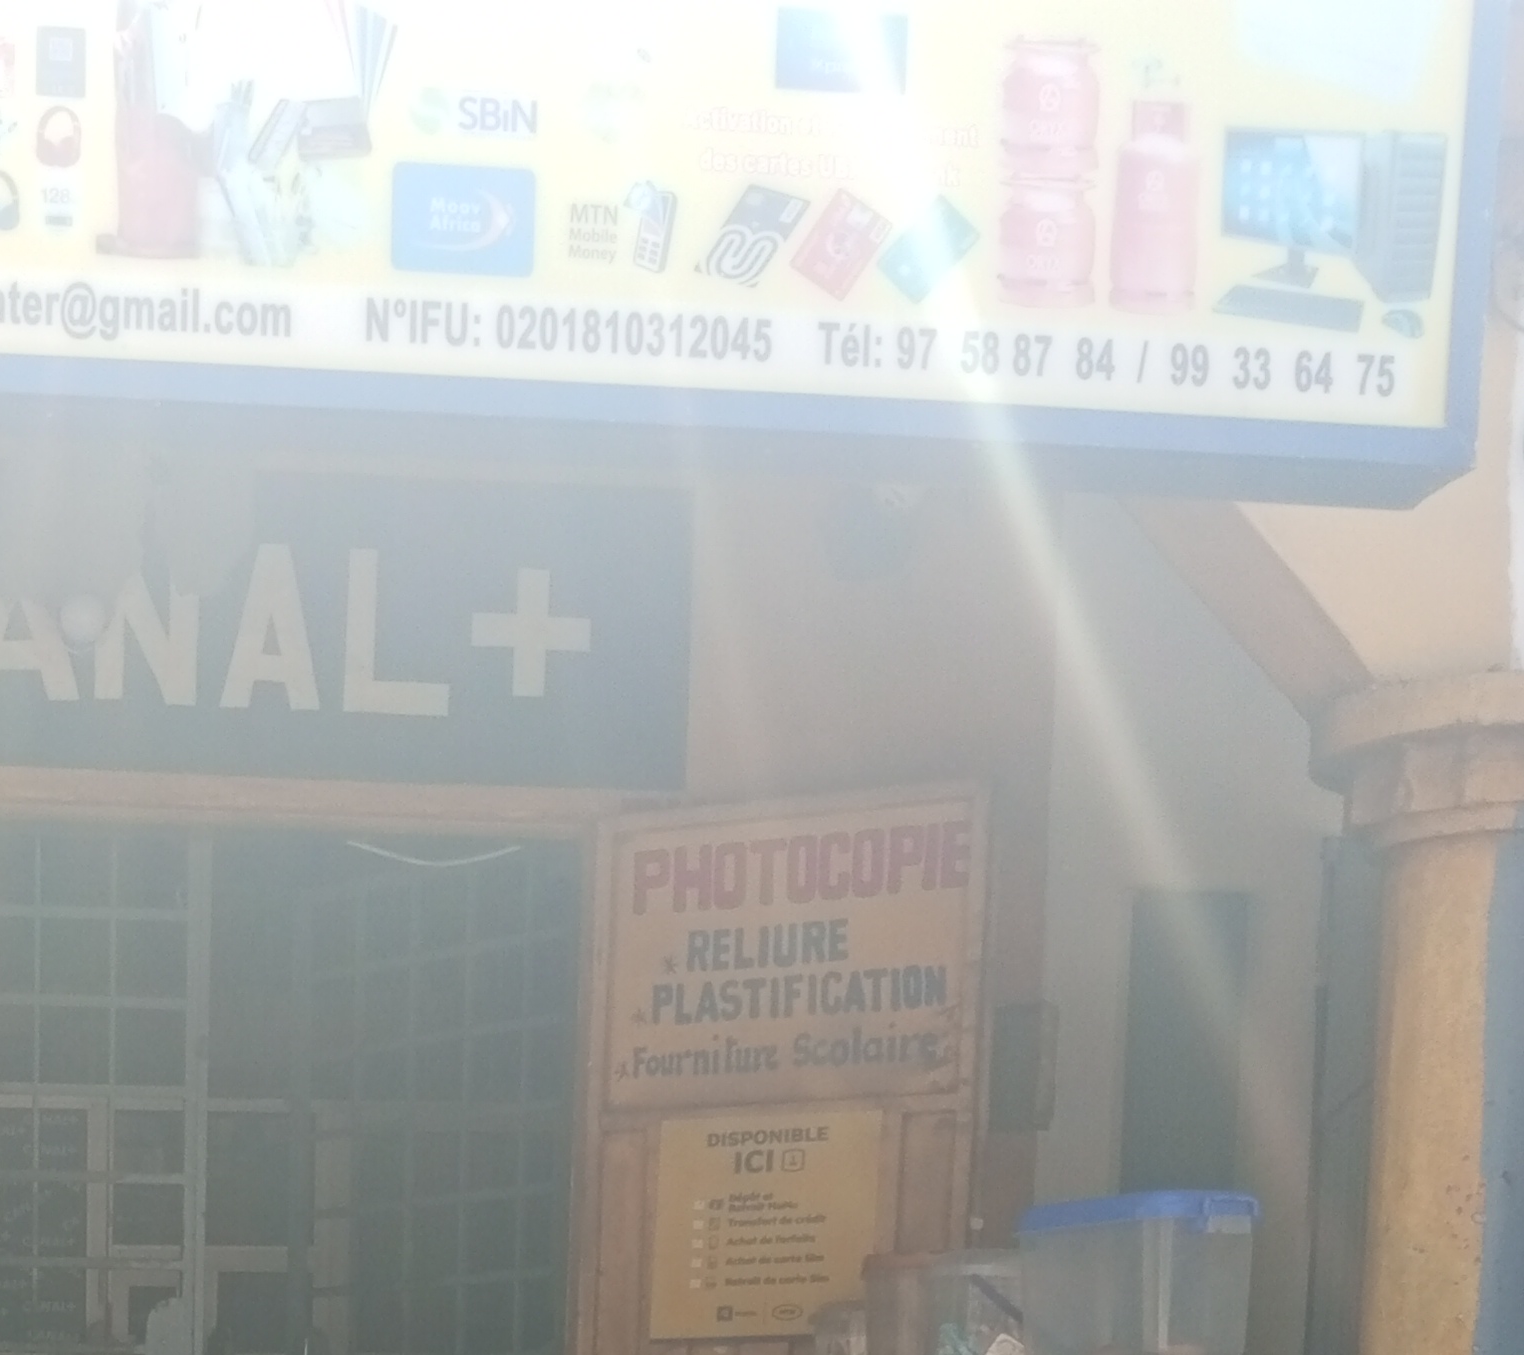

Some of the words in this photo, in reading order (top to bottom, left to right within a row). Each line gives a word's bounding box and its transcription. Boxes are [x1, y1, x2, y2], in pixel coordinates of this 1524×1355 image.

[457, 95, 538, 136] SBiN
[429, 197, 482, 215] Moov
[569, 203, 619, 226] MTN
[428, 214, 482, 233] Africa
[568, 226, 618, 244] Mobile
[567, 244, 618, 265] Money
[496, 304, 773, 363] 0201810312045
[818, 321, 883, 369] Tél:
[896, 327, 938, 371] 97
[961, 330, 1000, 375] 58
[1012, 334, 1054, 378] 87
[1076, 337, 1116, 382] 84
[1136, 340, 1149, 383] /
[1170, 343, 1211, 388] 99
[1233, 347, 1272, 392] 33
[1293, 350, 1333, 395] 64
[1356, 354, 1397, 398] 75
[632, 819, 973, 916] PHOTOCOPIE
[686, 918, 850, 973] RELIURE
[650, 964, 948, 1026] PLASTIFICATION
[632, 1034, 780, 1079] Fourniture
[707, 1126, 830, 1148] DISPONIBLE
[733, 1149, 775, 1175] ICI
